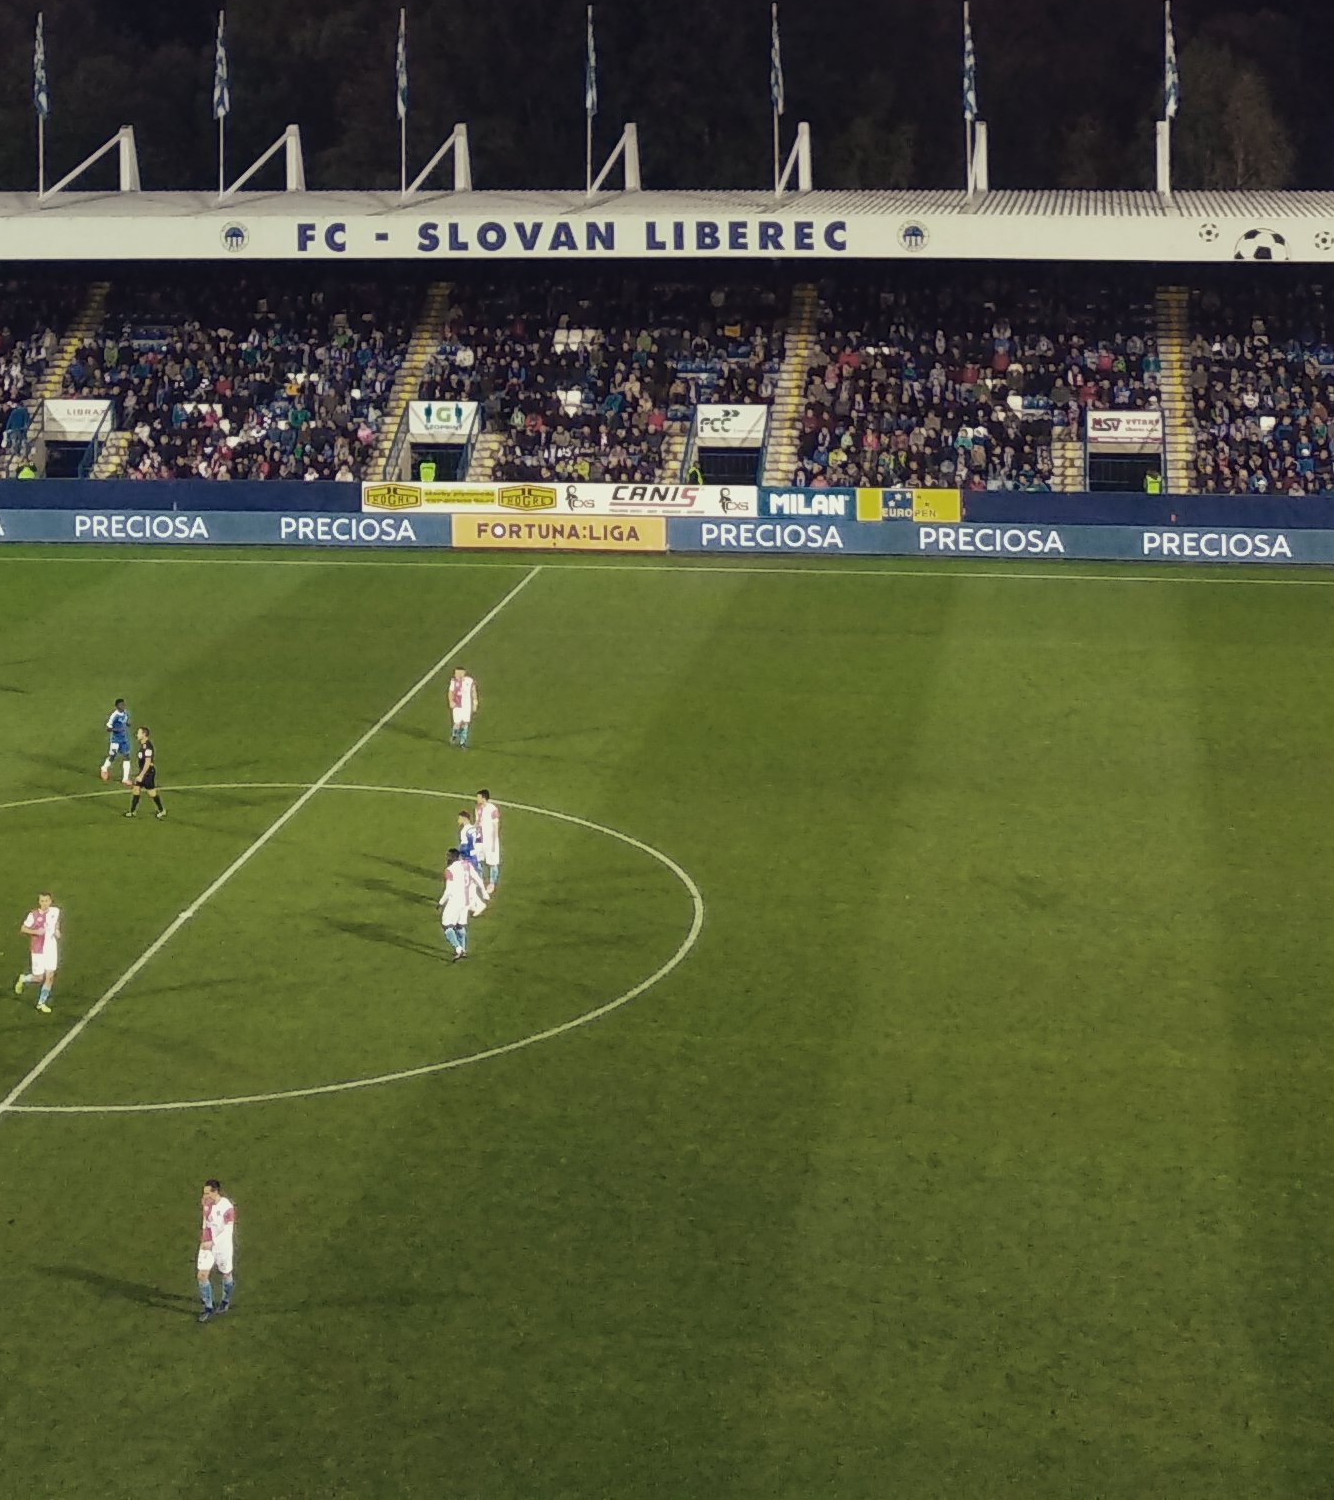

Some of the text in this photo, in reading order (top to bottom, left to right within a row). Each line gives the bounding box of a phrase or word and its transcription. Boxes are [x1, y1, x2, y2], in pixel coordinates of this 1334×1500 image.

[296, 221, 347, 252] FC
[417, 221, 615, 252] SLOVAN
[646, 220, 849, 251] LIBEREC
[611, 485, 700, 506] CANIS
[769, 493, 845, 516] MILAN
[75, 515, 209, 539] PRECIOSA
[280, 517, 417, 541] PRECIOSA
[701, 523, 844, 548] PRECIOSA
[919, 527, 1065, 553] PRECIOSA
[1143, 532, 1292, 558] PRECIOSA
